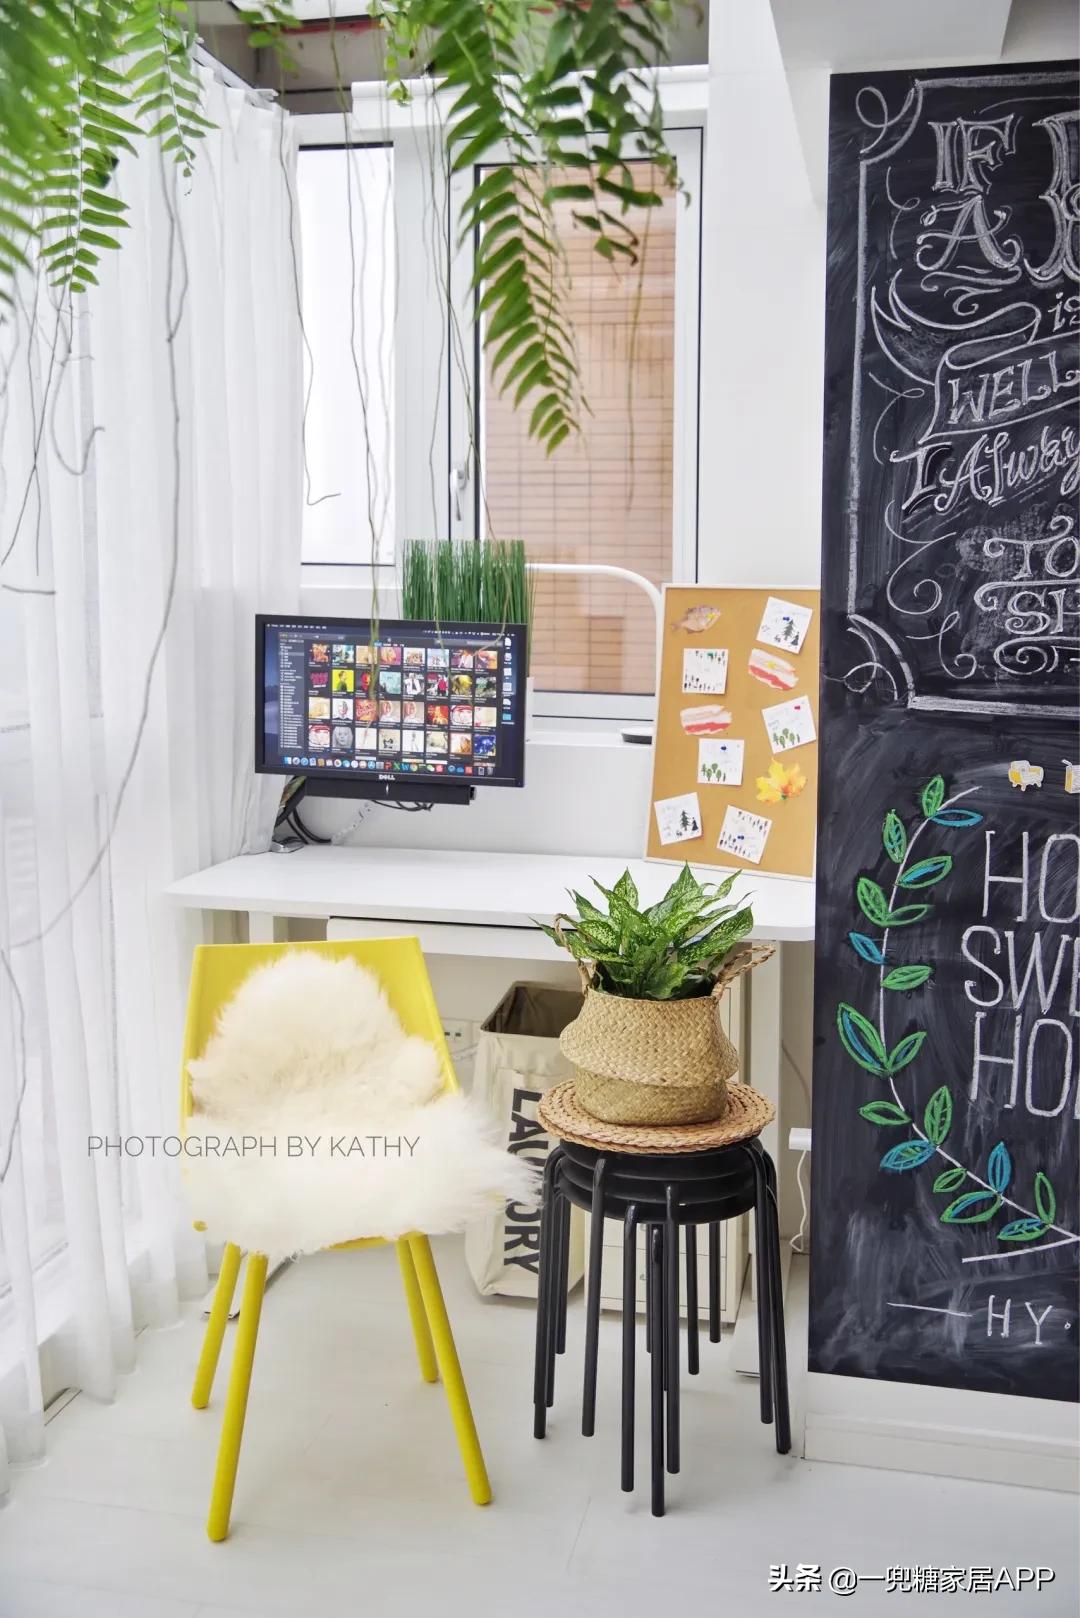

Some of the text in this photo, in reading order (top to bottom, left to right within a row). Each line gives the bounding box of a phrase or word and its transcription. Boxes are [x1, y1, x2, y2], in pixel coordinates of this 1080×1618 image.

[928, 113, 1020, 194] IF
[915, 195, 1021, 271] A
[947, 350, 1080, 425] WELL
[983, 515, 1079, 580] TO
[970, 1011, 1080, 1117] HO
[503, 1088, 549, 1275] LAUDRY
